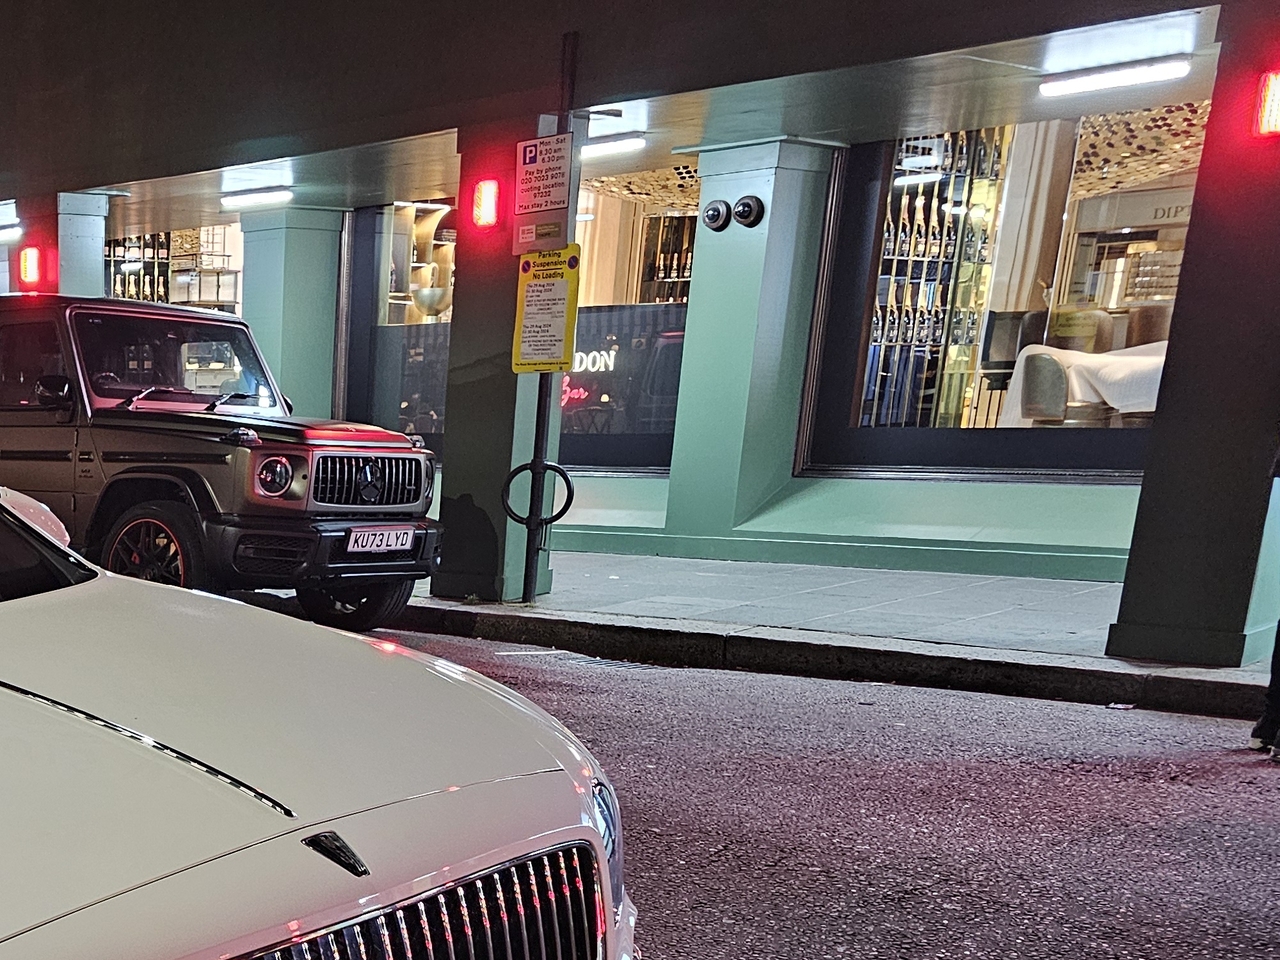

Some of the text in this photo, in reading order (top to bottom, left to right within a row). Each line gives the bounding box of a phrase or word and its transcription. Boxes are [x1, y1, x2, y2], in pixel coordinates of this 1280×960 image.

[526, 146, 535, 163] P
[539, 148, 552, 156] 8.30
[542, 155, 555, 163] 6.30
[520, 182, 565, 193] quoting location
[538, 251, 561, 259] Parking
[532, 260, 566, 268] Suspension
[352, 532, 408, 548] KU73 LYD
